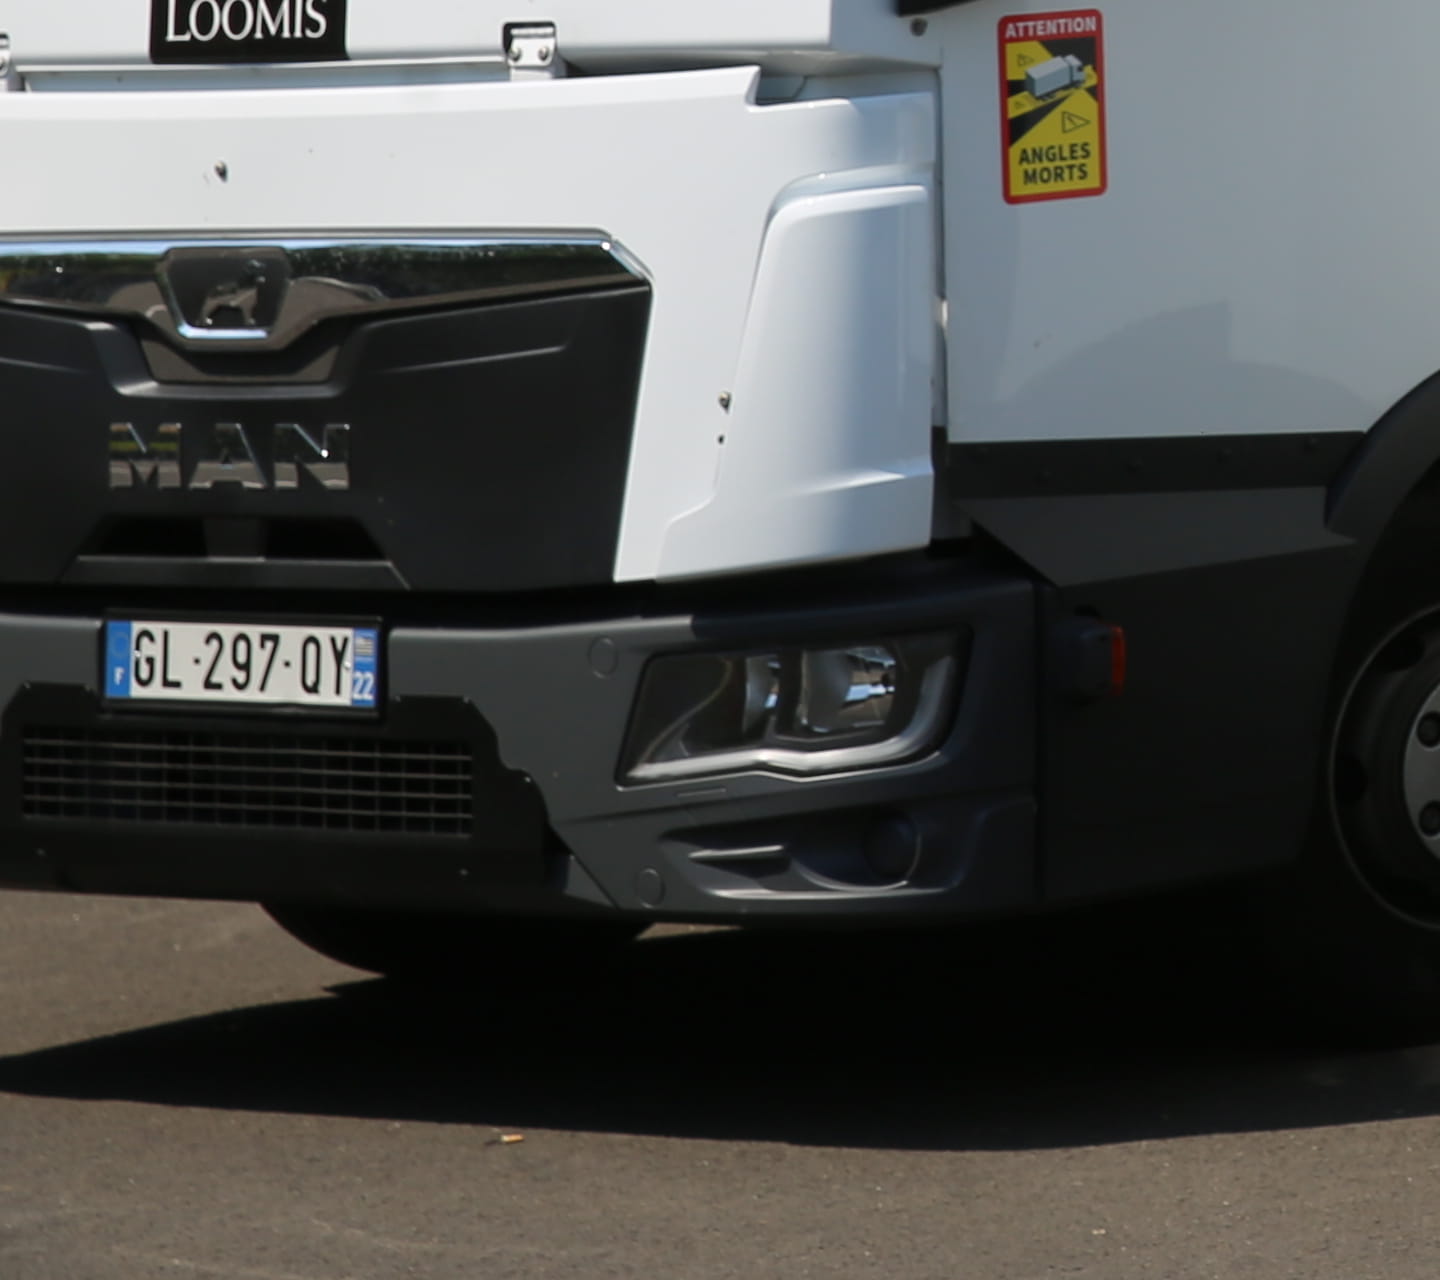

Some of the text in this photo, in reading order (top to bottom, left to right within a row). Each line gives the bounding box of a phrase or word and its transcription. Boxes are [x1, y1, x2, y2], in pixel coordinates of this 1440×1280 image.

[1005, 15, 1097, 39] ATTENTION
[1018, 141, 1092, 166] ANGLES
[1023, 162, 1089, 186] MORTS
[109, 422, 351, 490] MAN
[353, 671, 375, 701] 22
